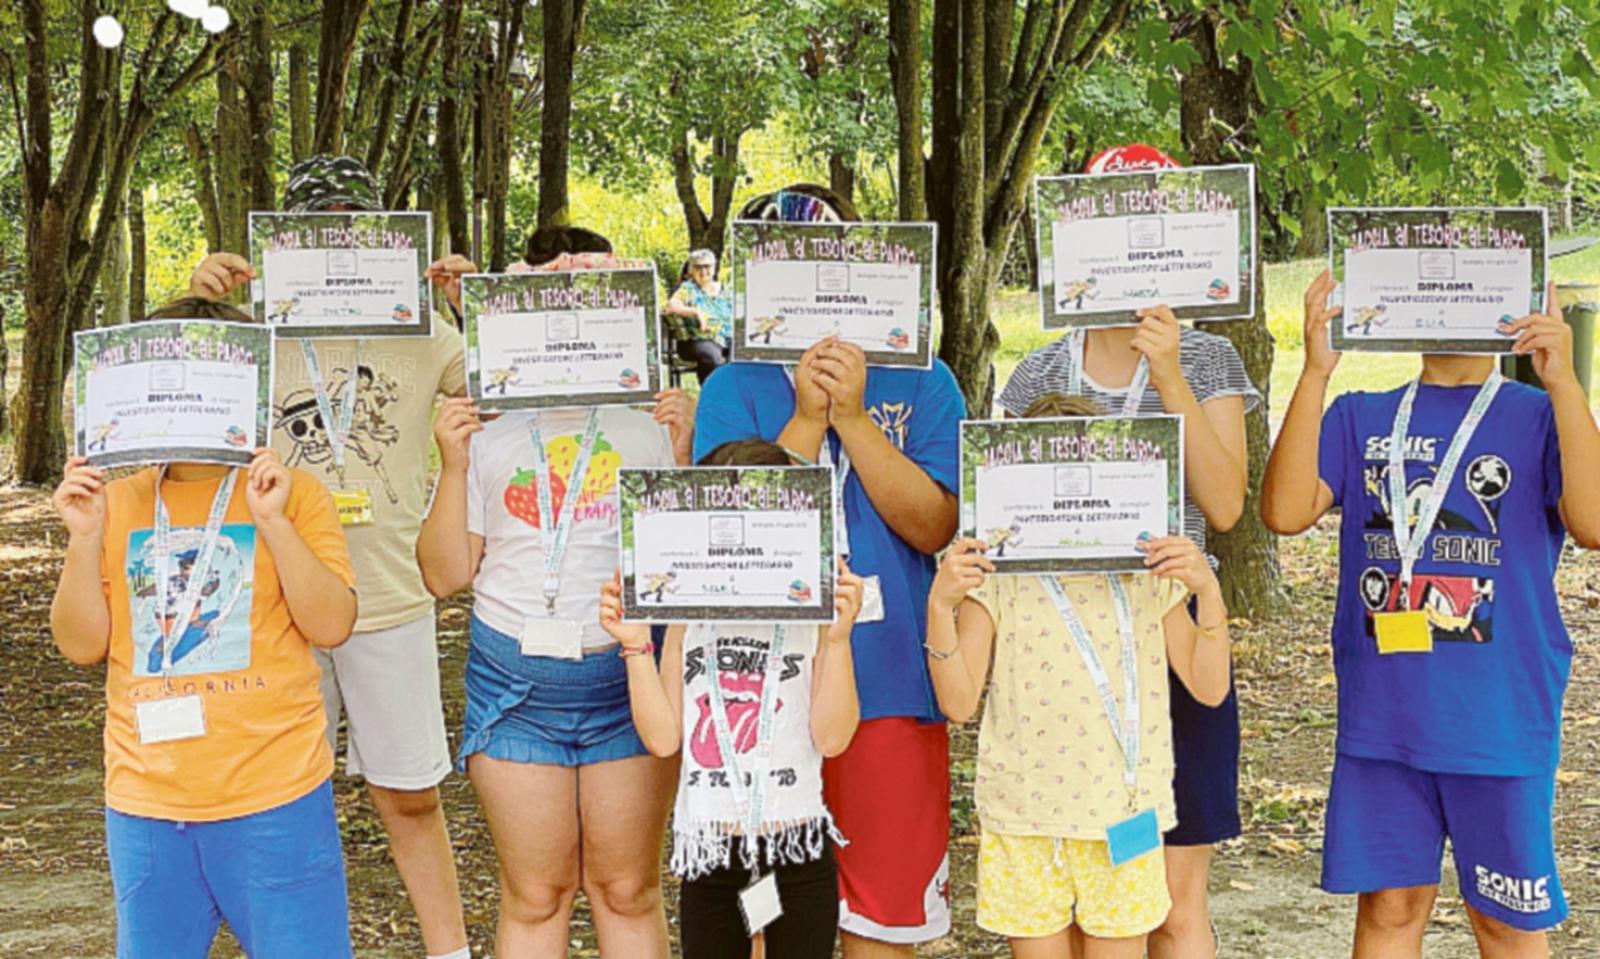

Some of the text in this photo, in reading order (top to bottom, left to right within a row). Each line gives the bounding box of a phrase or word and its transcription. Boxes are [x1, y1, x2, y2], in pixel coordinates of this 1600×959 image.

[1364, 533, 1501, 565] TE SONIC
[684, 646, 804, 684] SONES
[127, 676, 266, 699] ALIORNIA
[1475, 864, 1547, 901] SONIC
